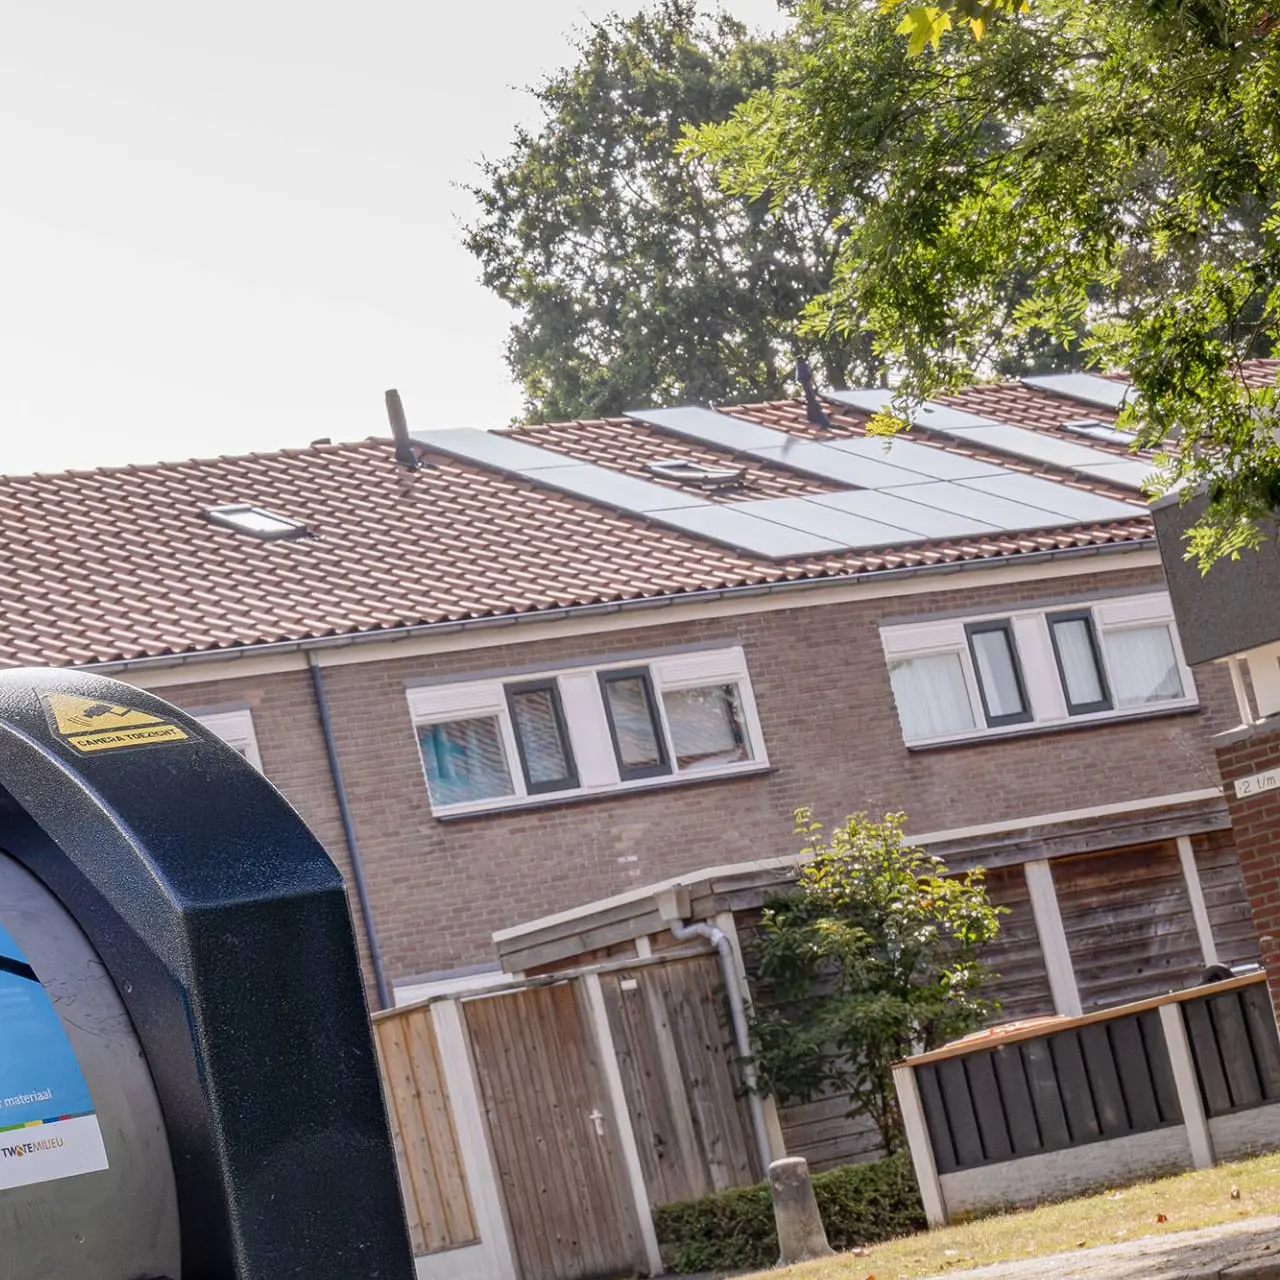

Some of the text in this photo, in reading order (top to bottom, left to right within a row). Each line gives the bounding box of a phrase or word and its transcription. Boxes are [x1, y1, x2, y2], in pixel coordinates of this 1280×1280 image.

[76, 729, 177, 747] CAMERA TOEZICHT
[4, 1088, 53, 1108] materiaal
